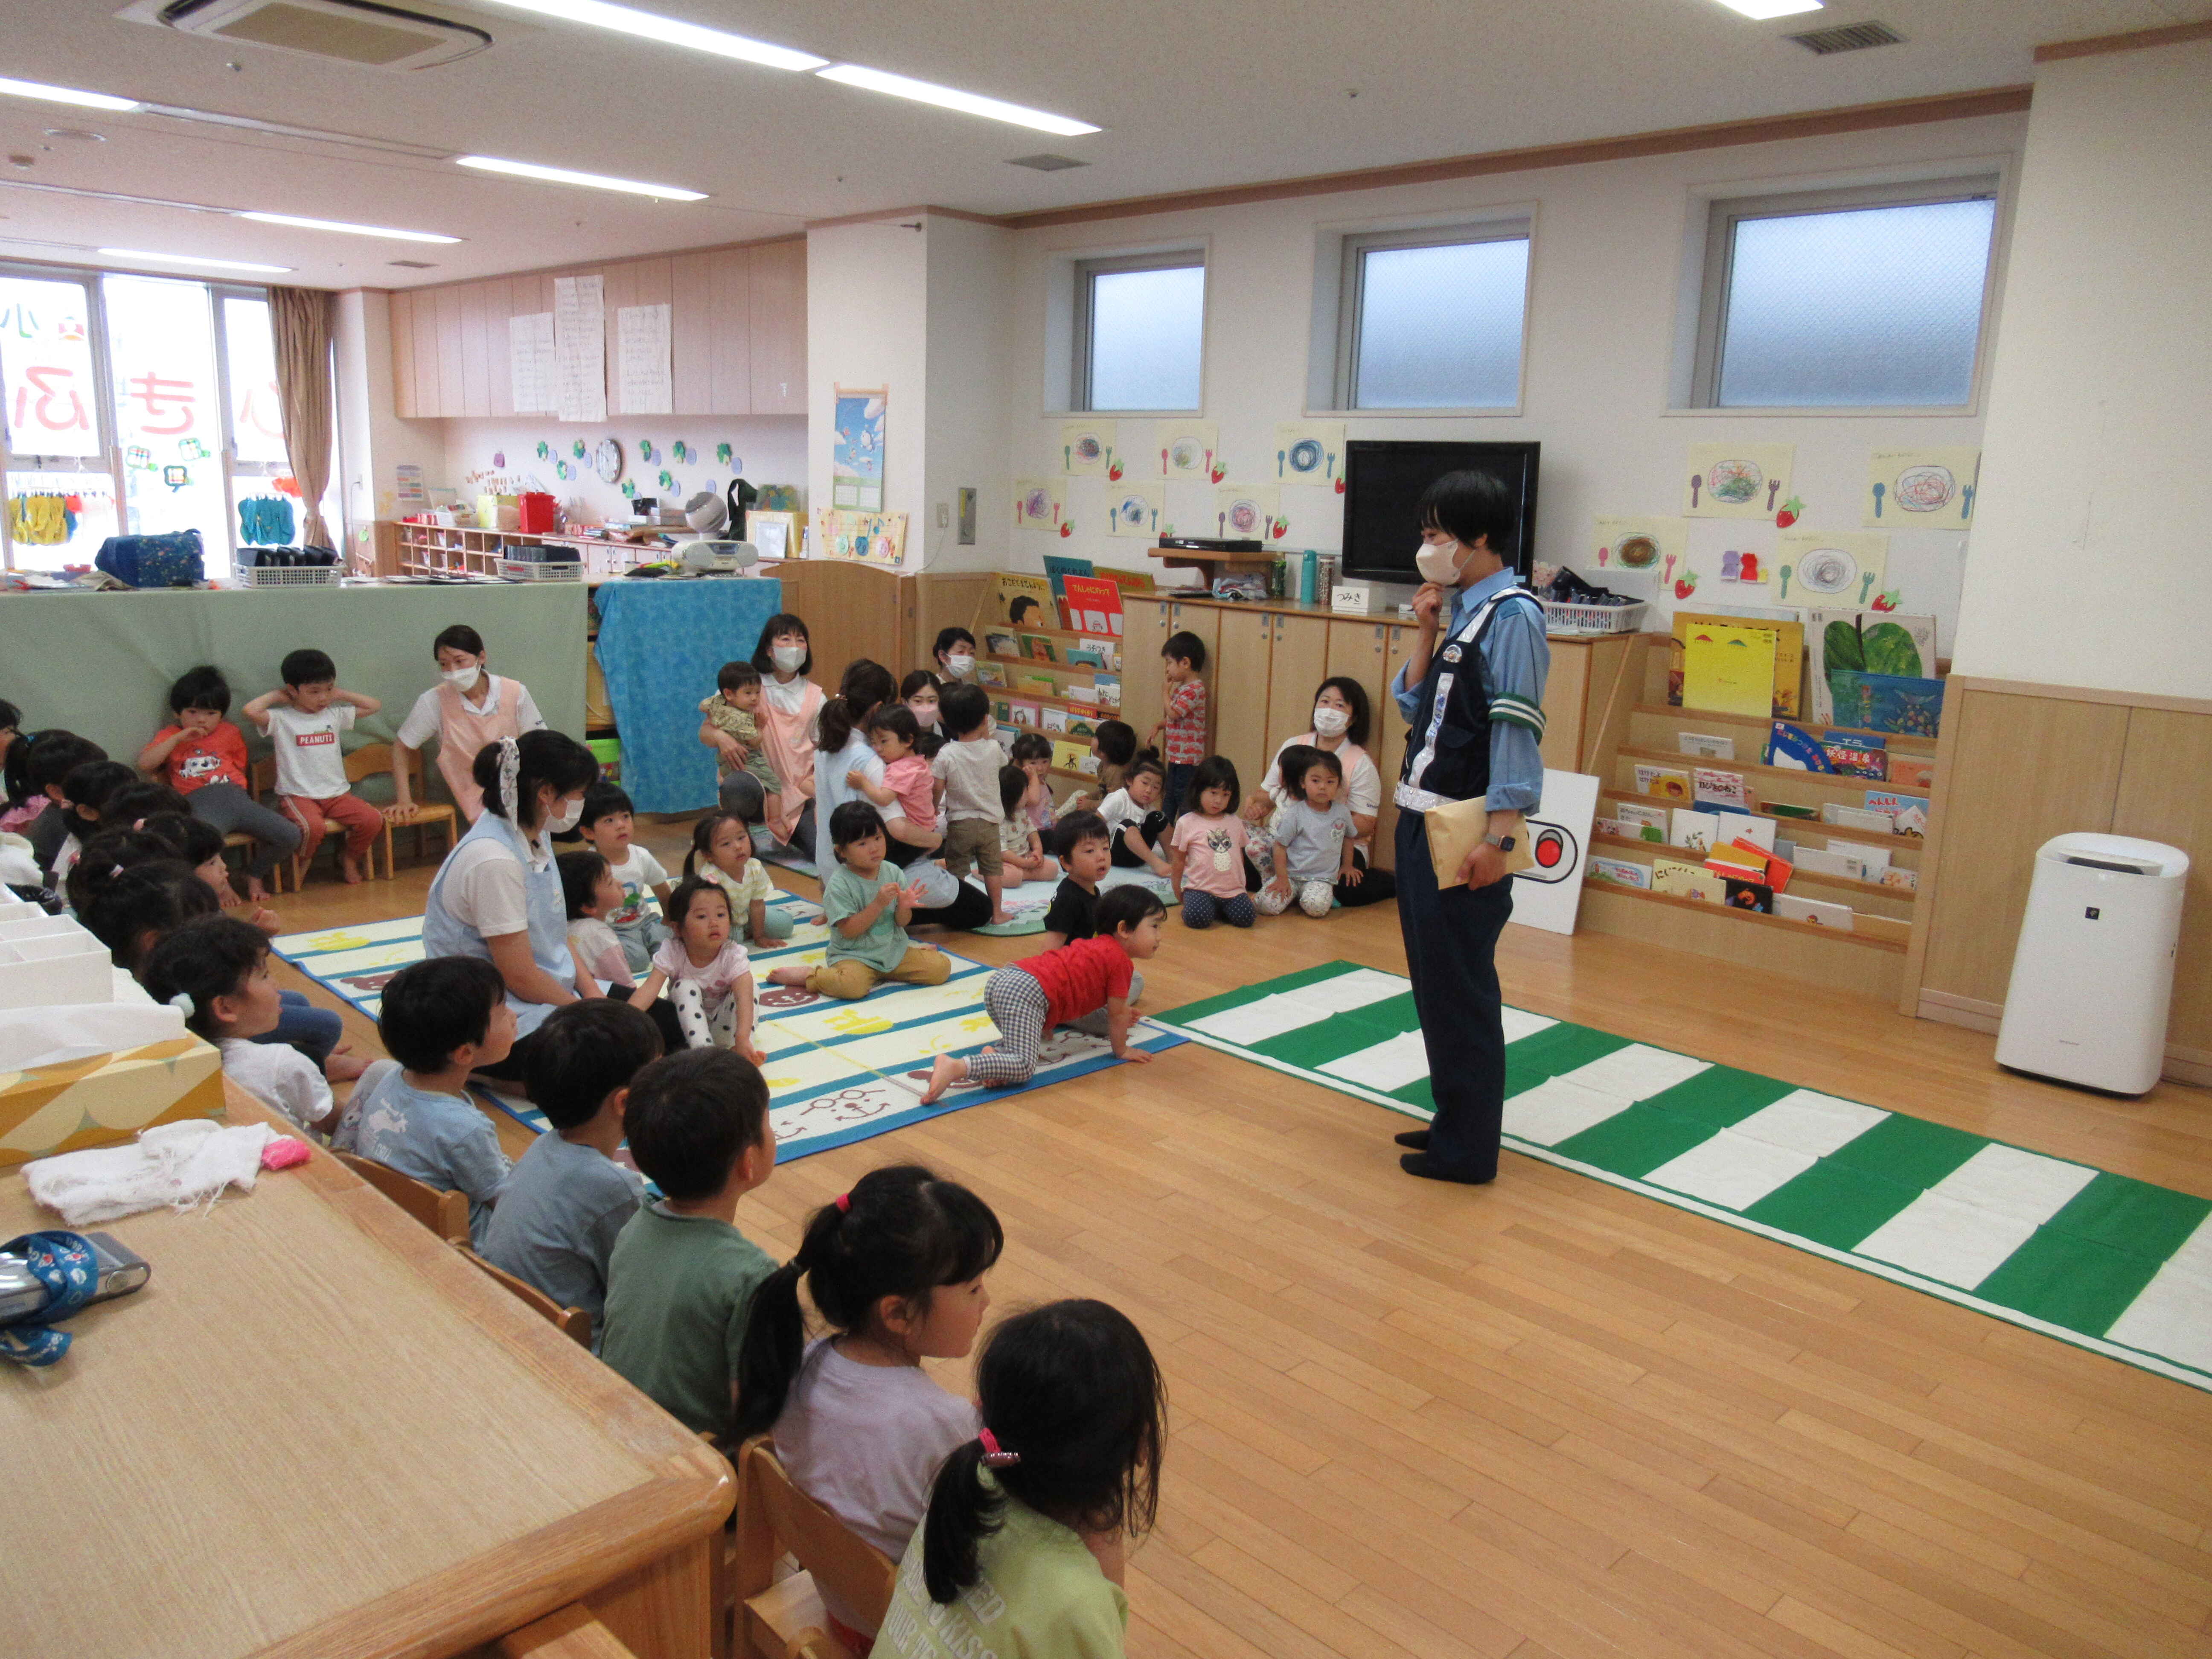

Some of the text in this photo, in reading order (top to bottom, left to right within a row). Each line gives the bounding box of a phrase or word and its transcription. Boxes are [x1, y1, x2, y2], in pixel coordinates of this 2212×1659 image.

[1337, 592, 1361, 605] つみき
[300, 733, 333, 744] PEANUTS
[1826, 748, 1871, 764] 妖怪温泉
